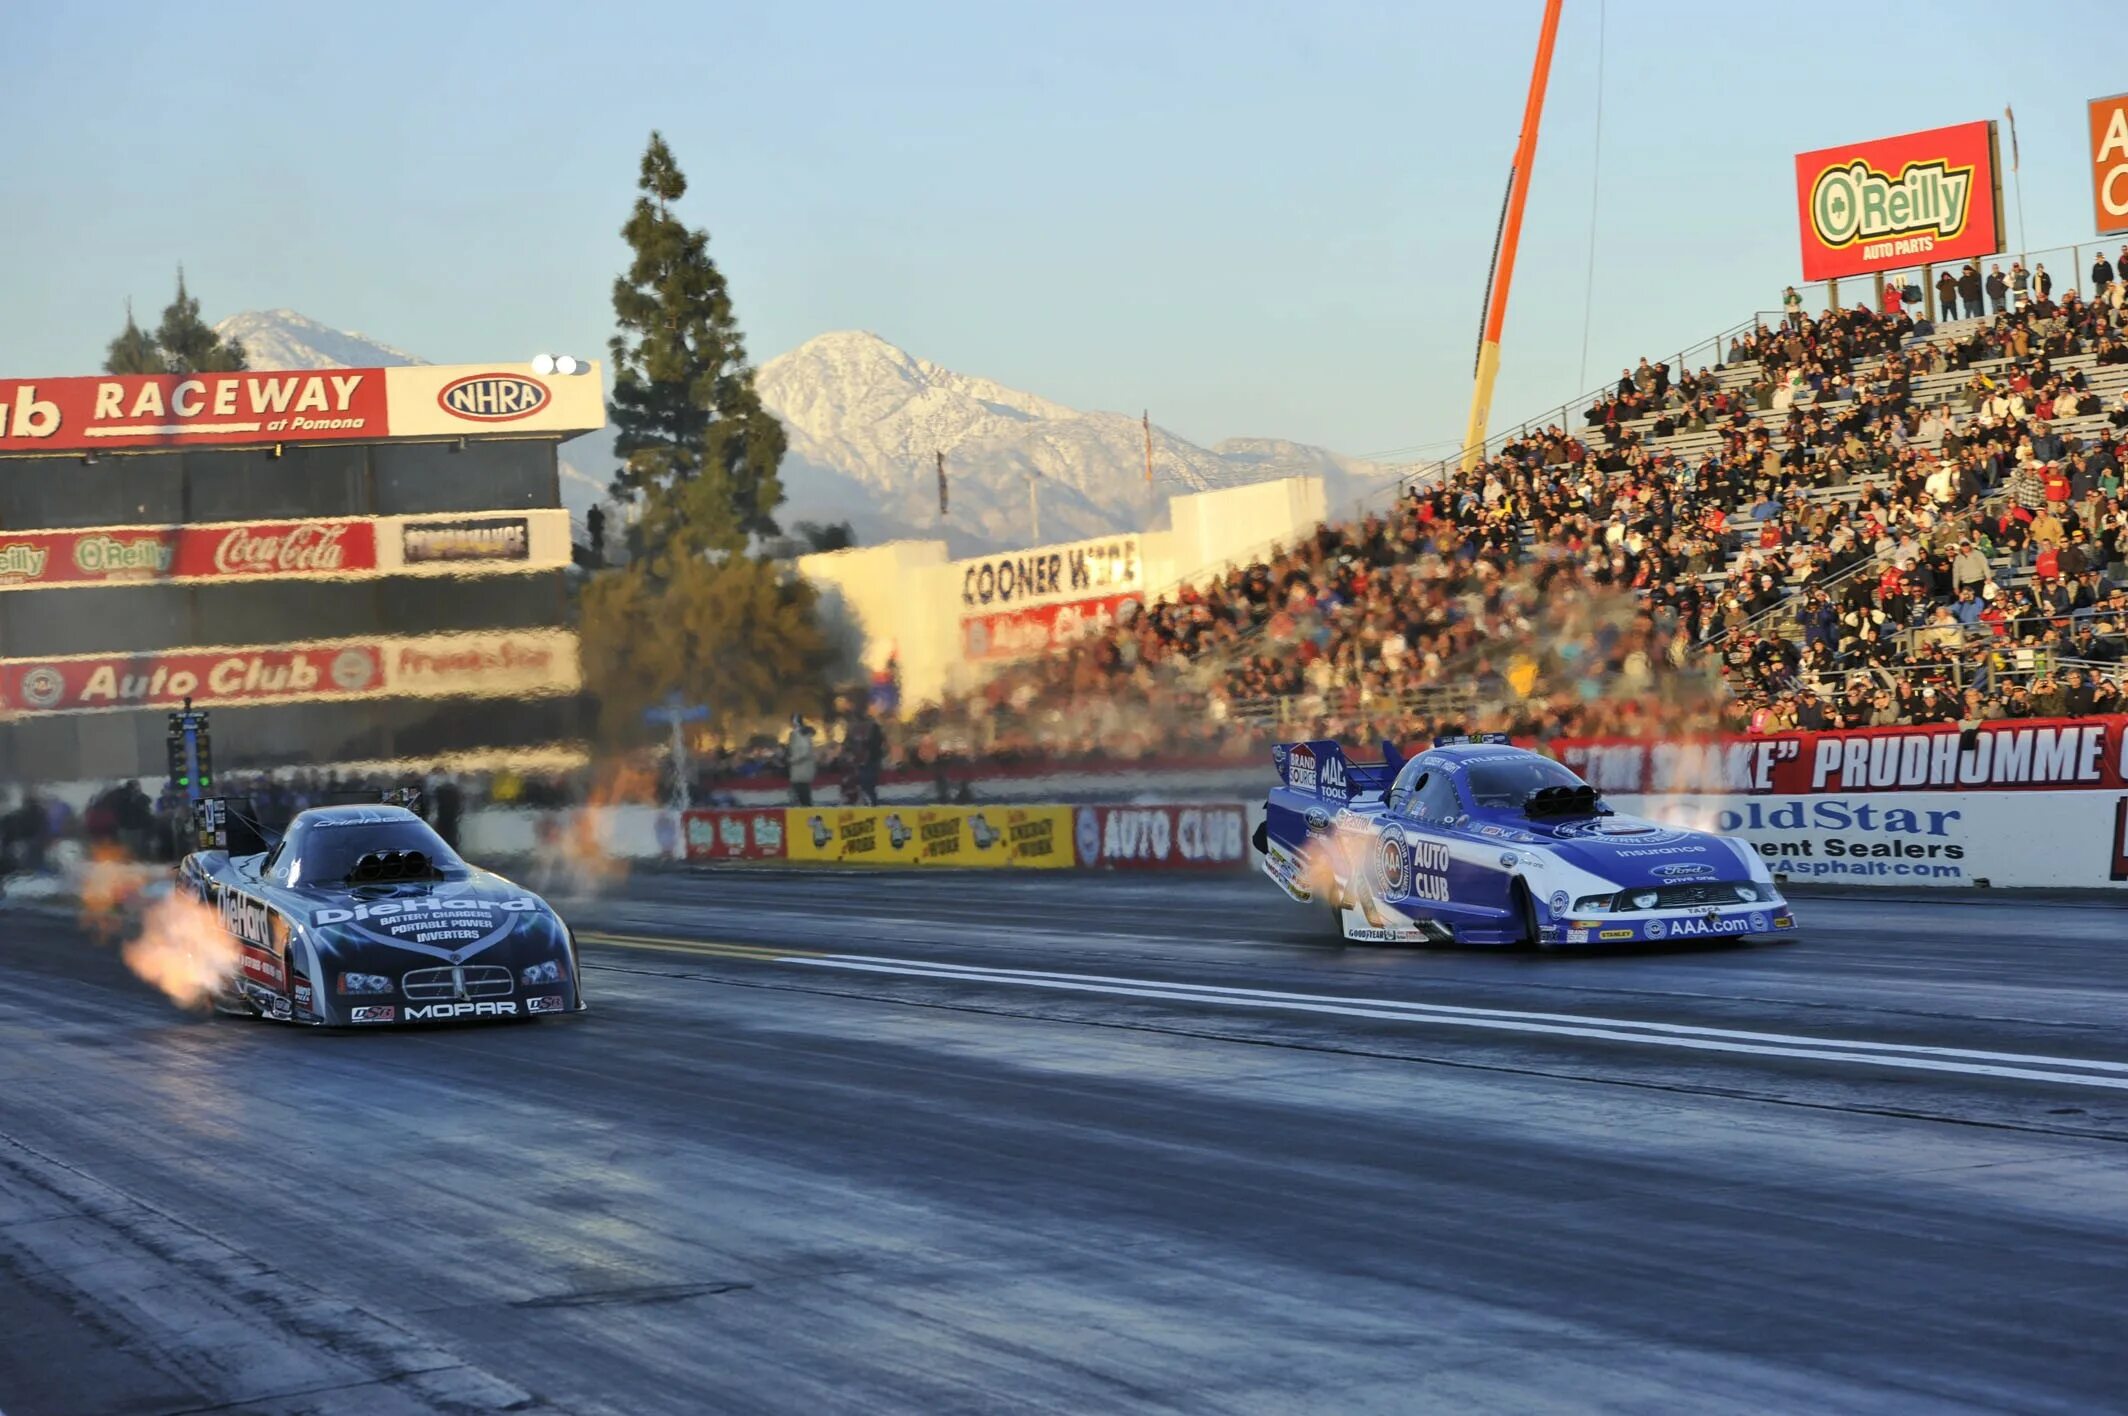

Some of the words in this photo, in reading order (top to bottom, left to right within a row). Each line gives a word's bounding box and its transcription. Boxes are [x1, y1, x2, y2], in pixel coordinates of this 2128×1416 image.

[1815, 167, 1970, 241] O'Reilly
[1863, 242, 1894, 261] AUTO
[1895, 235, 1934, 255] PARTS
[0, 384, 61, 438] b
[94, 375, 364, 420] RACEWAY
[452, 380, 538, 414] NHRA
[267, 418, 289, 432] at
[291, 416, 366, 431] Pomona
[77, 536, 174, 572] O'Reilly
[214, 523, 349, 574] Coca-Cola
[79, 664, 199, 701] Auto
[207, 653, 319, 695] Club
[1290, 752, 1316, 770] BRAND
[1812, 726, 2106, 788] PRUDHOMME
[1289, 767, 1317, 787] SOURCE
[1321, 756, 1347, 788] MAC
[1321, 785, 1347, 800] TOOLS
[1660, 800, 1962, 836] oldStar
[1103, 809, 1171, 860] AUTO
[1177, 809, 1243, 861] CLUB
[1413, 841, 1450, 872] AUTO
[1615, 845, 1707, 858] Insurance
[1824, 838, 1965, 859] Sealers
[1384, 850, 1402, 873] AAA
[1663, 864, 1702, 876] Ford
[1415, 872, 1450, 902] CLUB
[1663, 876, 1694, 885] Drive
[216, 884, 271, 948] DieHard
[315, 897, 535, 926] DieHard
[380, 912, 429, 926] BATTERY
[432, 910, 493, 920] CHARGERS
[1687, 906, 1721, 914] TASCA
[391, 919, 449, 936] PORTABLE
[451, 918, 494, 930] POWER
[416, 929, 480, 943] INVERTERS
[1348, 928, 1384, 940] GOODYEAR
[1670, 918, 1749, 936] AAA.com
[404, 1001, 518, 1021] MOPAR
